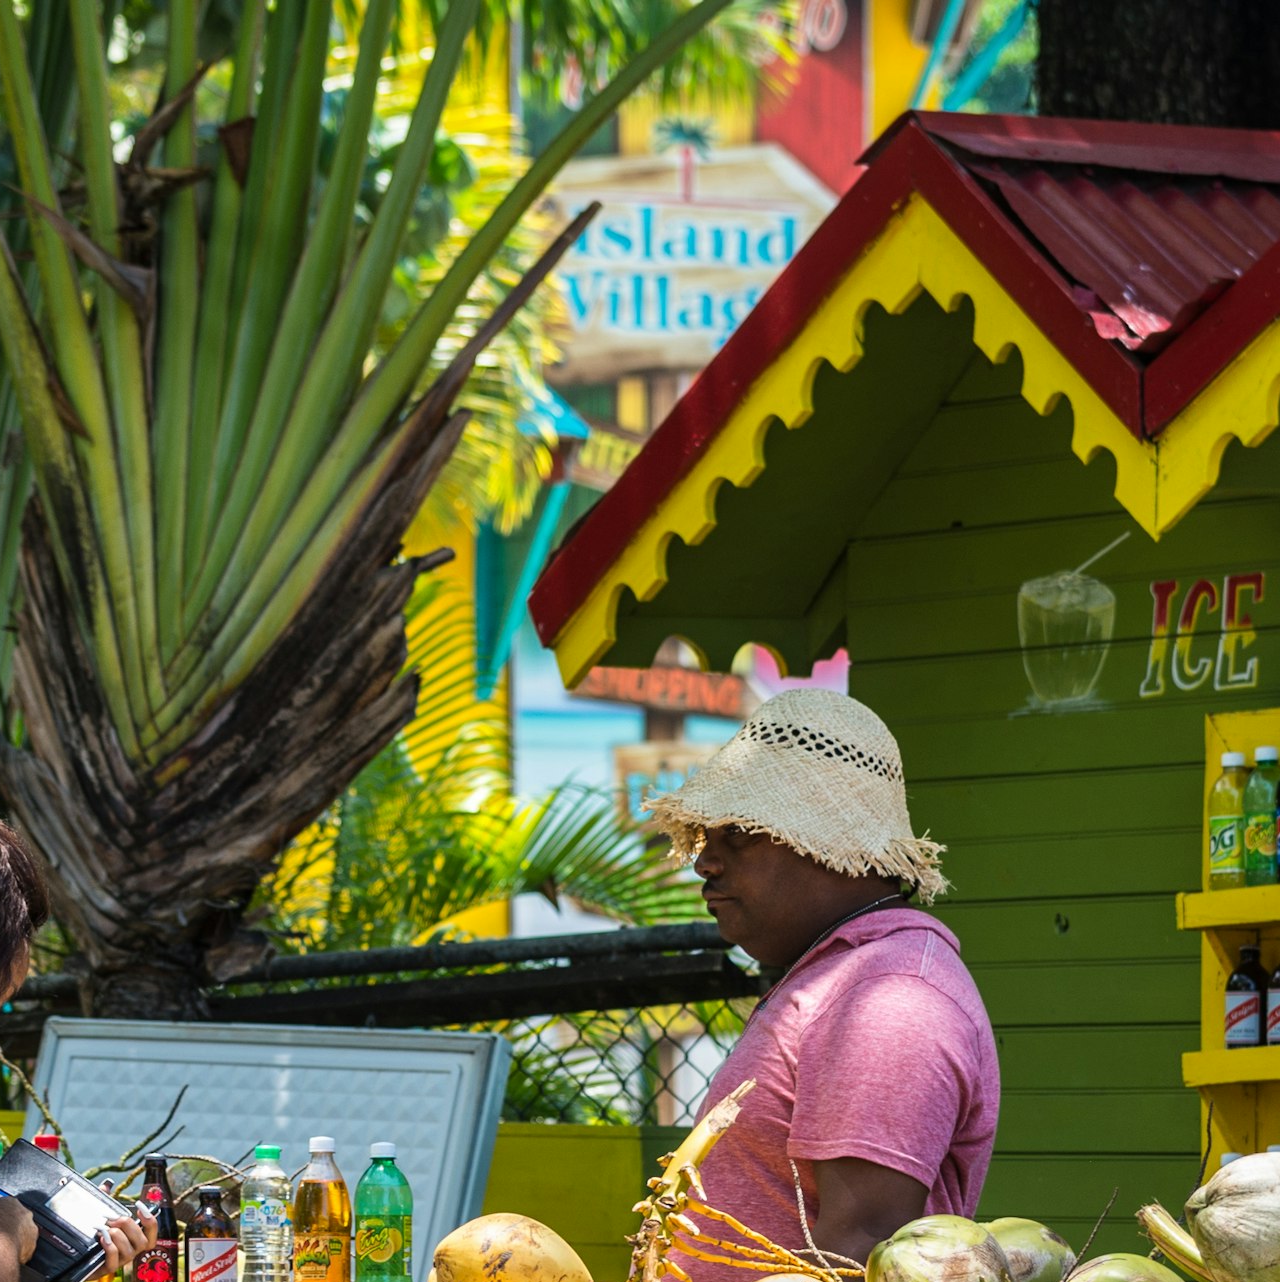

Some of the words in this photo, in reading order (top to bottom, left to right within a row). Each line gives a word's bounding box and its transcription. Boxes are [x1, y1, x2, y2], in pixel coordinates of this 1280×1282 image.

[560, 271, 760, 348] Villag
[1139, 571, 1264, 698] ICE
[140, 1249, 171, 1266] DRAGON
